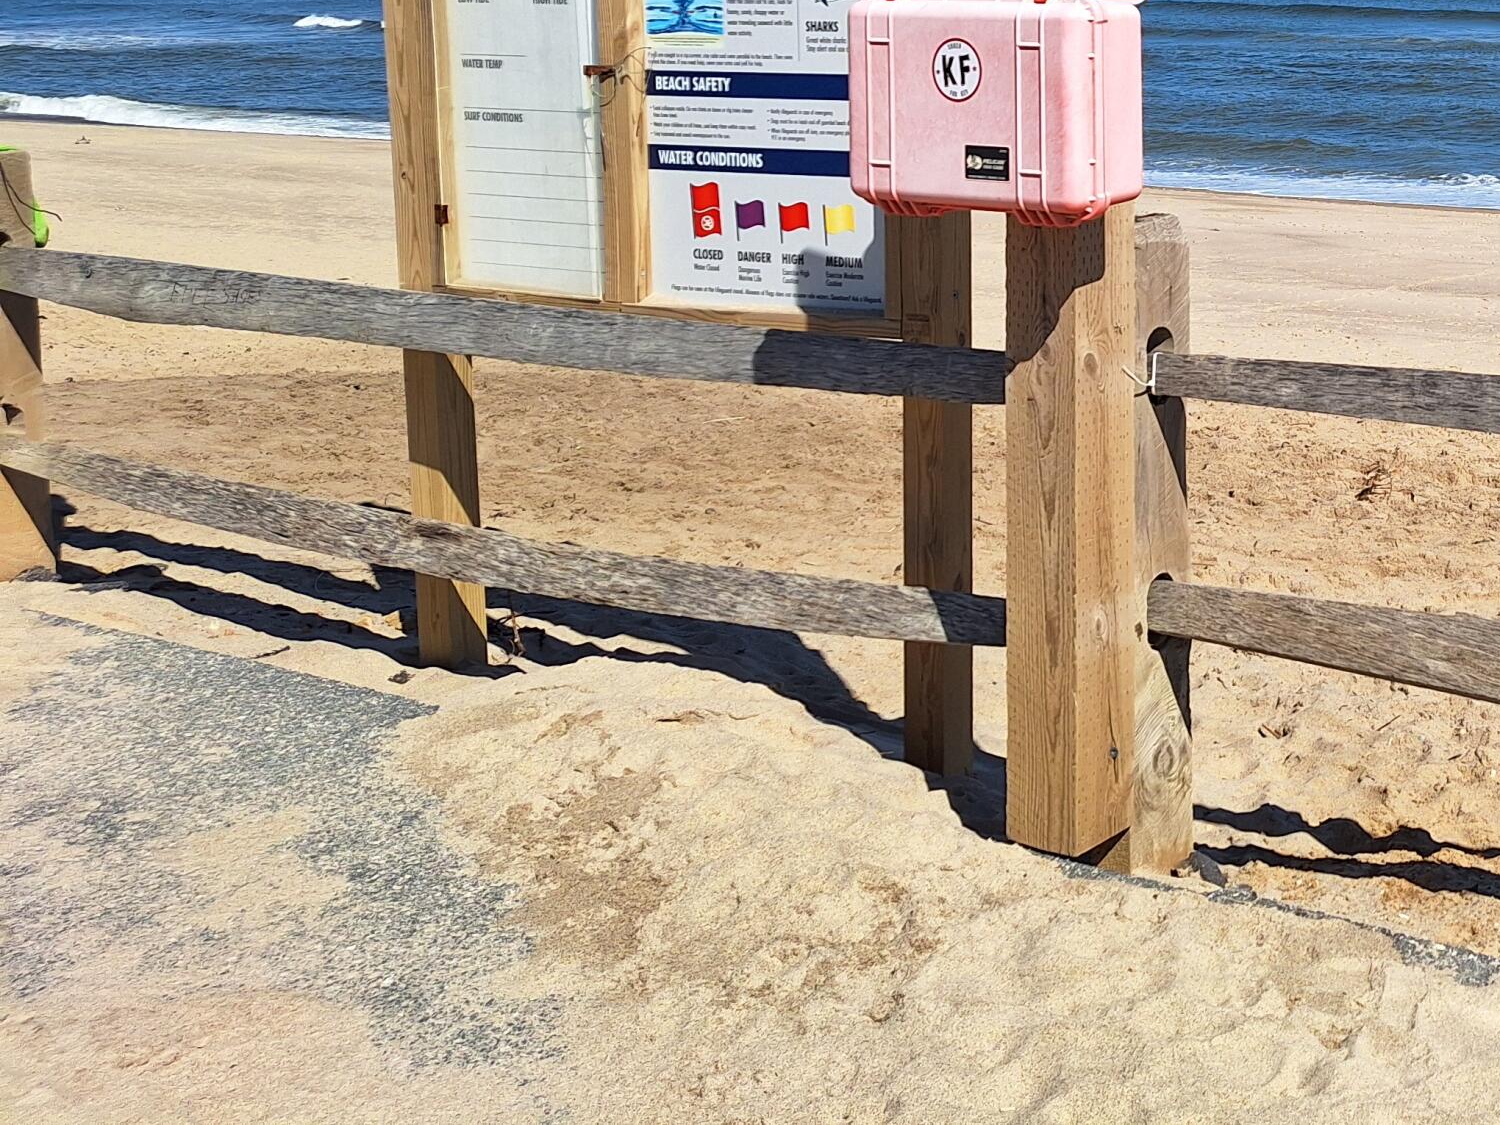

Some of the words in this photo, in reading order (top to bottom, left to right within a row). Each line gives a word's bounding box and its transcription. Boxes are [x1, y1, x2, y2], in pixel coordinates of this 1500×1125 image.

[805, 21, 839, 32] SHARKS
[462, 59, 484, 69] WATER
[485, 59, 503, 69] TEMP
[942, 54, 970, 87] KF
[655, 75, 690, 91] BEACH
[692, 76, 732, 92] SAFETY
[464, 111, 480, 121] SURF
[482, 112, 523, 123] CONDITIONS
[658, 150, 695, 165] WATER
[696, 152, 763, 168] CONDITIONS
[693, 248, 723, 260] CLOSED
[737, 251, 771, 263] DANGER
[781, 253, 804, 265] HIGH
[825, 256, 863, 268] MEDIUM
